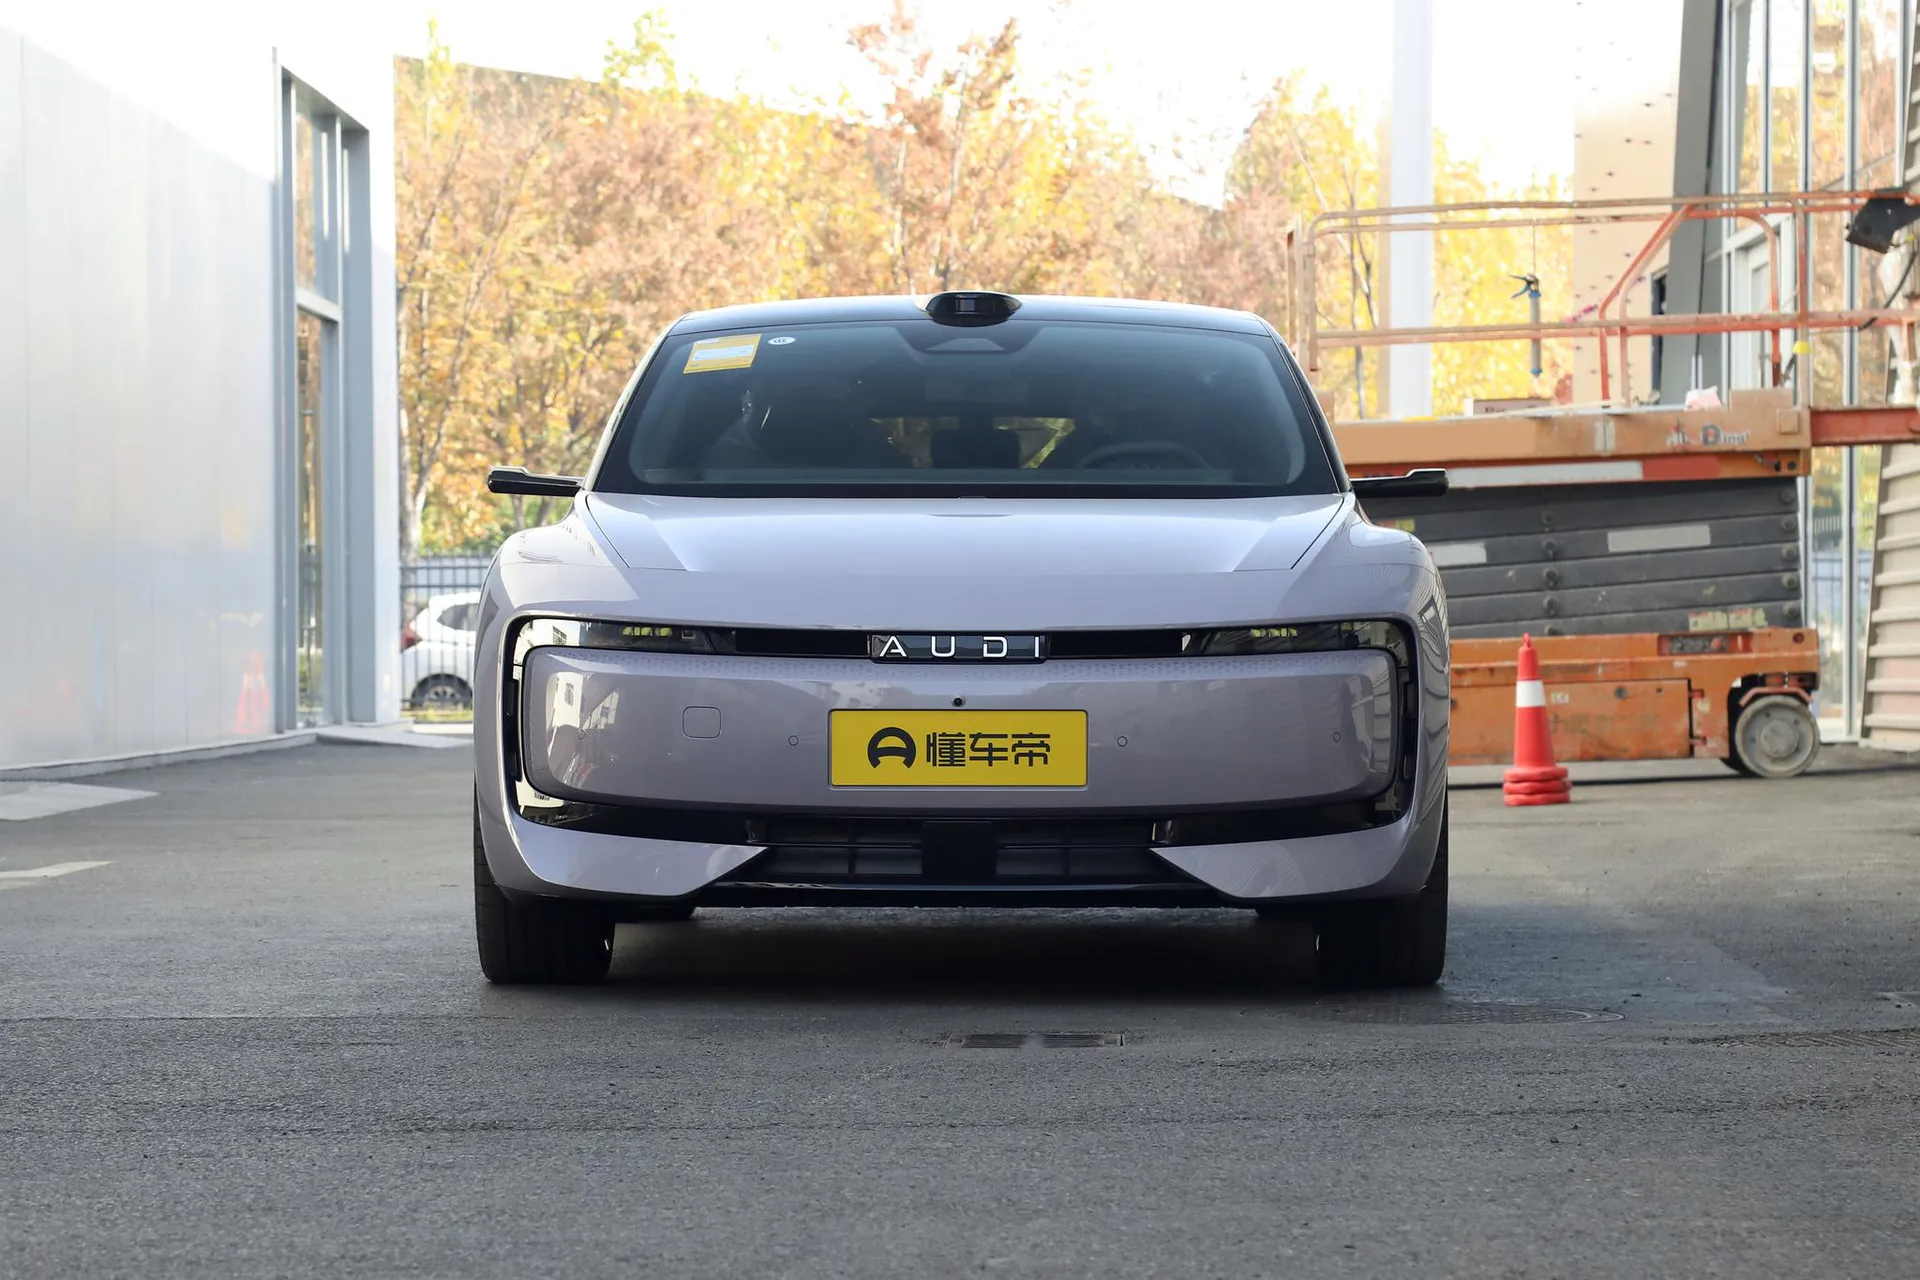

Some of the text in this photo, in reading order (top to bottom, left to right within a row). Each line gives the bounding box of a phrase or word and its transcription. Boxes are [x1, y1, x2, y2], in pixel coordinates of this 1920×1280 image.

[878, 635, 1040, 658] AUDI
[926, 731, 1051, 767] 懂车帝
